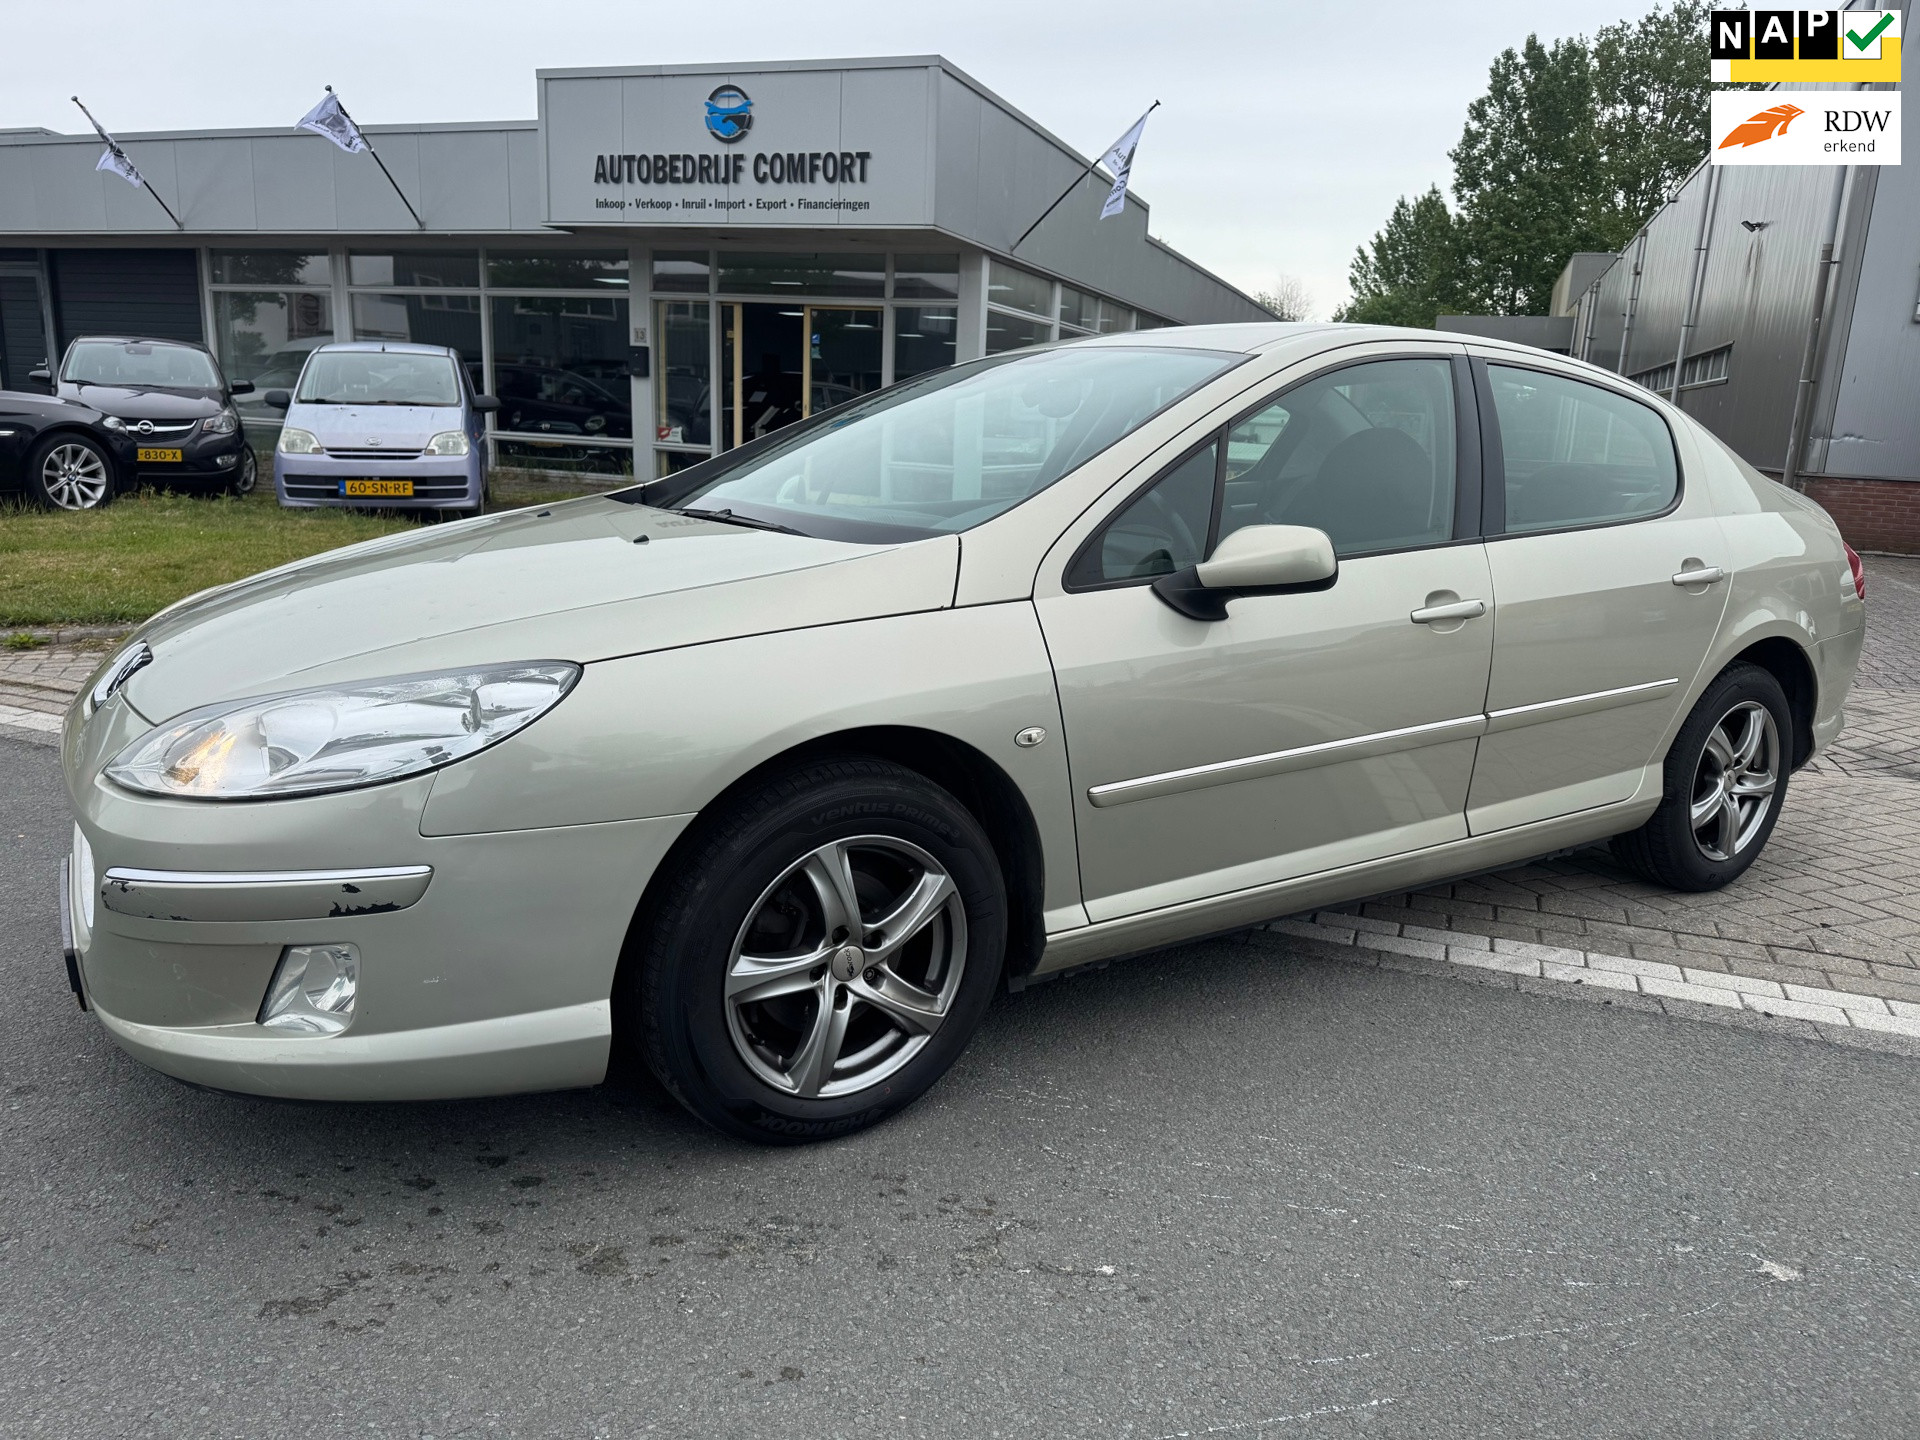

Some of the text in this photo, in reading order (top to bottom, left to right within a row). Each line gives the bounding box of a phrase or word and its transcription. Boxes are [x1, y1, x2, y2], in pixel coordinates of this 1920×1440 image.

[594, 151, 871, 184] AUTOBEDRIJF COMFORT
[595, 198, 870, 212] Inkoop Verkoop Inruil Import Export Financieringen
[139, 450, 178, 460] -830-X
[349, 482, 409, 494] 60-SN-RF
